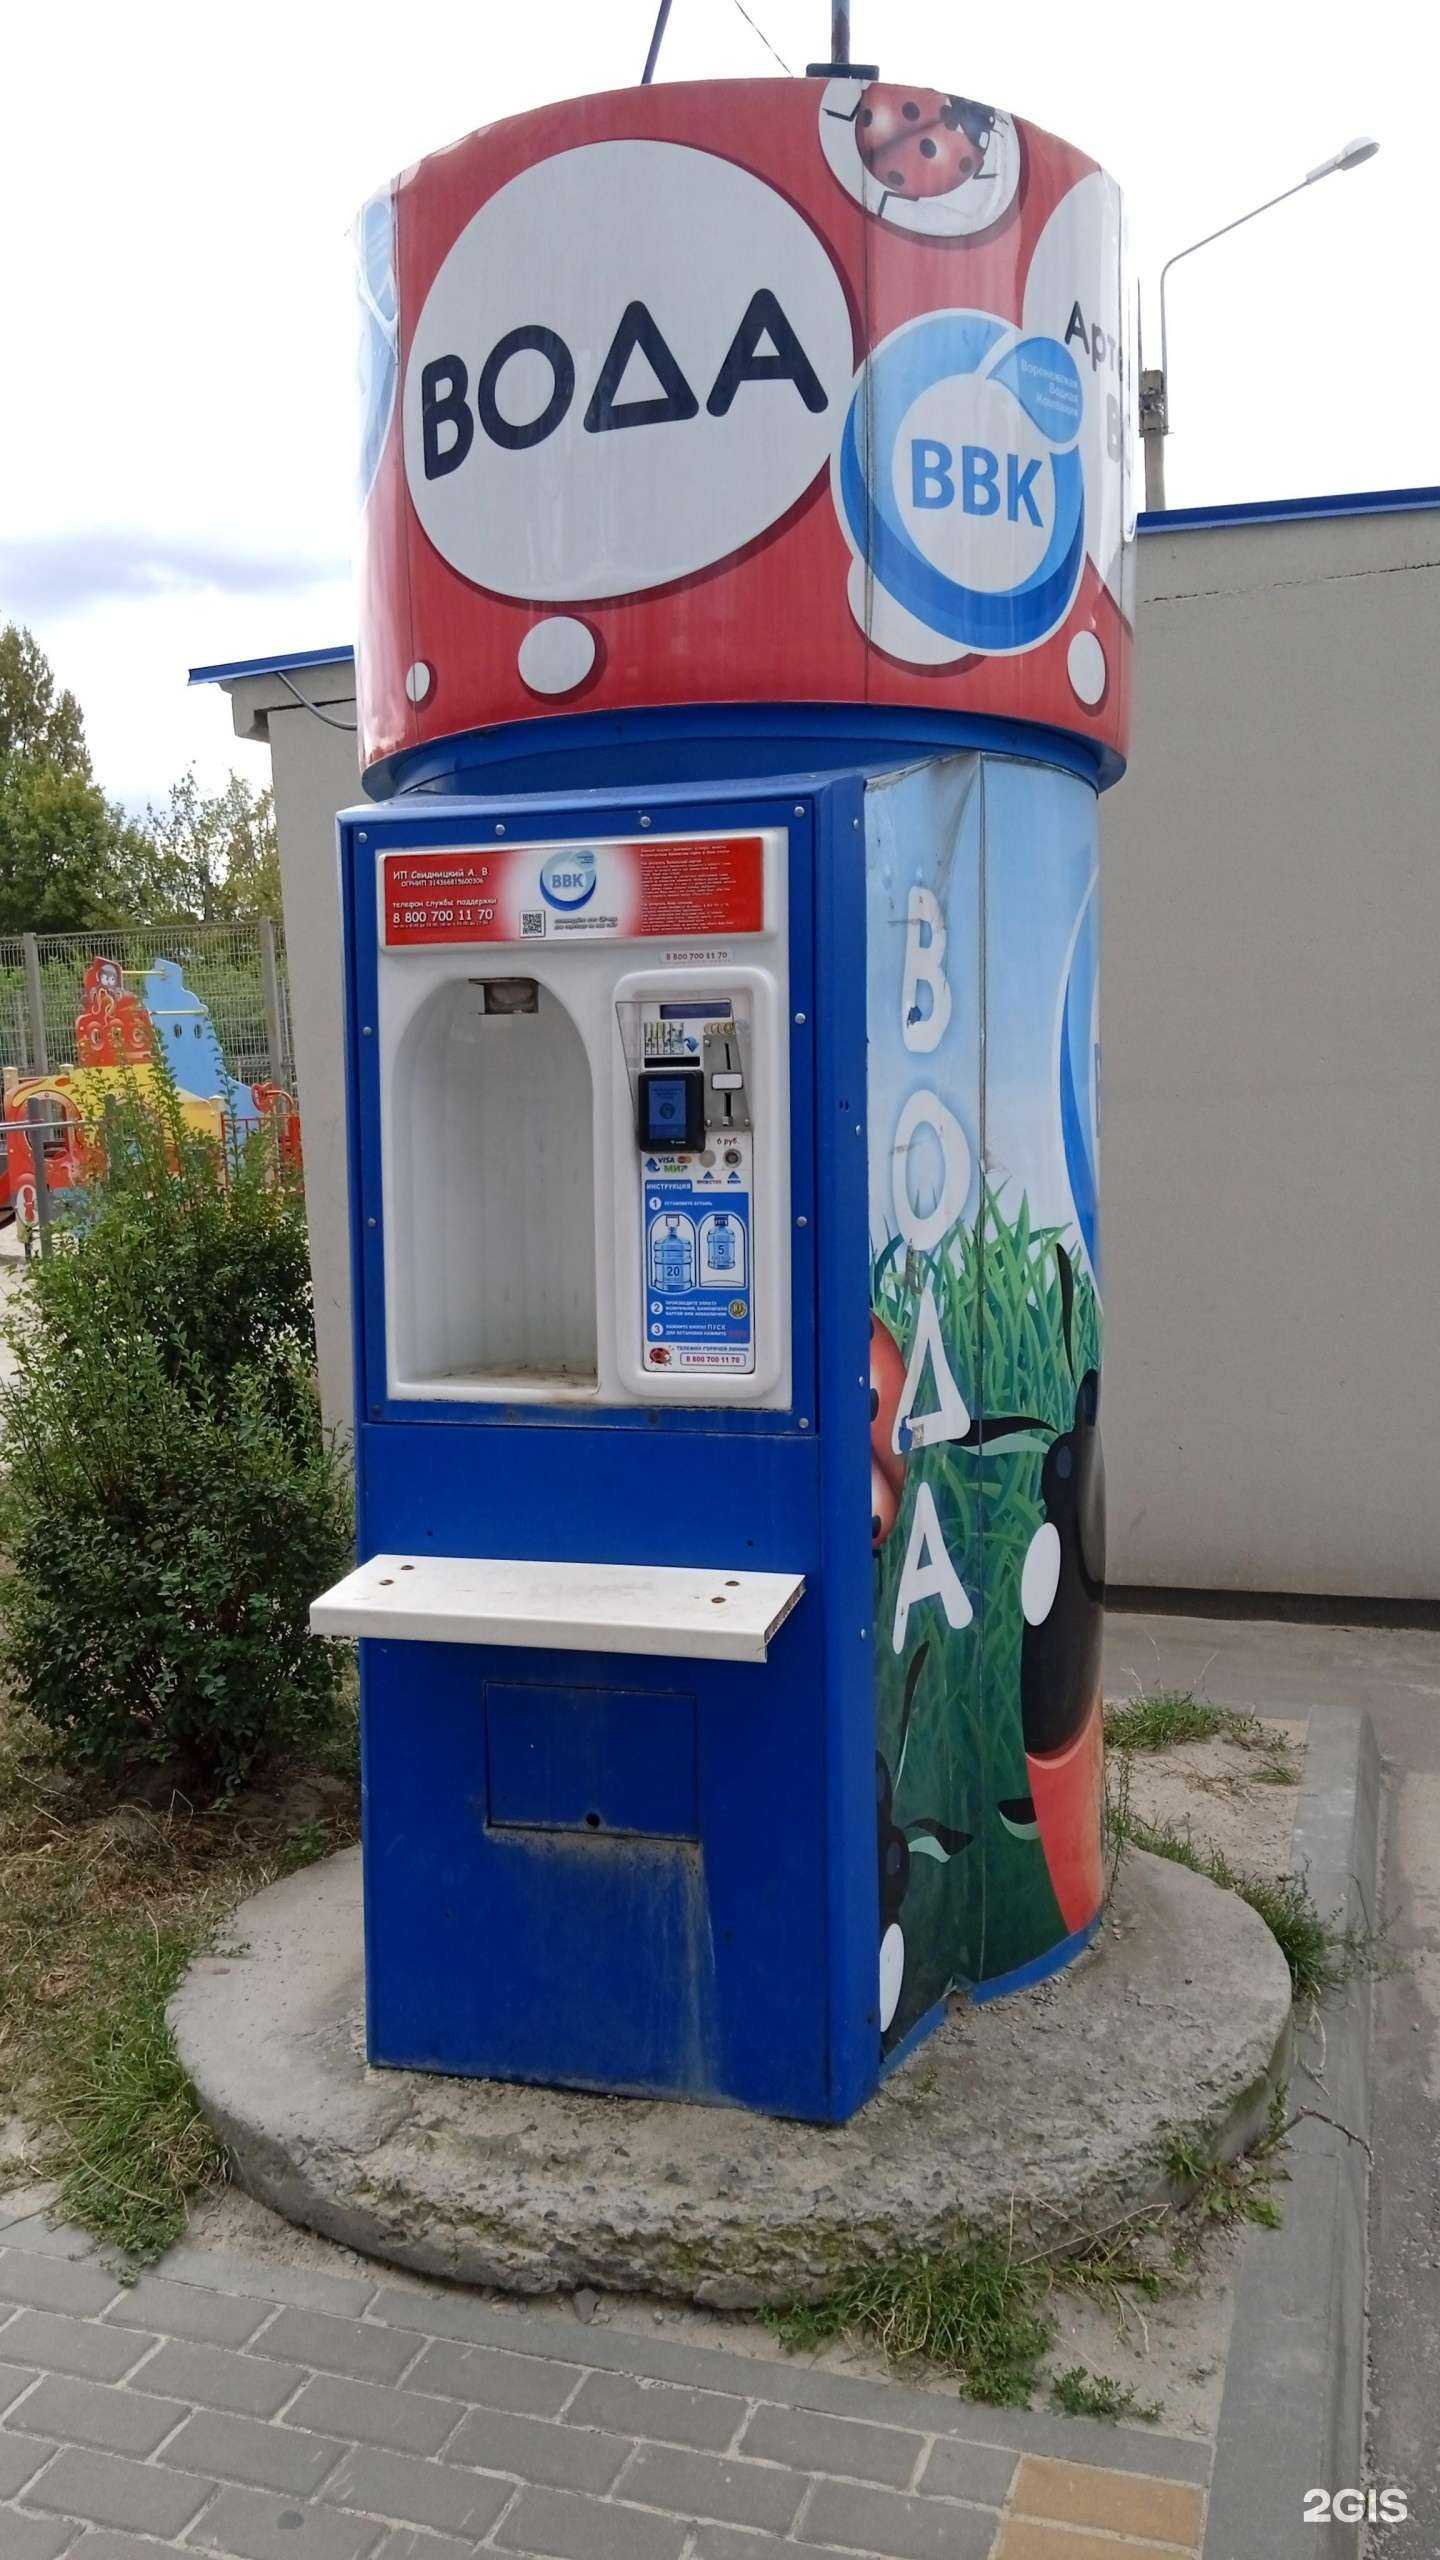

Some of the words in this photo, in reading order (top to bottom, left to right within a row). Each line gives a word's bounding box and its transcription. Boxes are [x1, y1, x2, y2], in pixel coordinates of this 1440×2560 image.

[421, 288, 829, 481] ВОДА
[910, 438, 1044, 529] ВВК
[393, 870, 408, 880] ИП
[411, 868, 464, 879] Свидницкий
[393, 901, 424, 909] телефон
[426, 898, 454, 908] службы
[457, 898, 497, 907] поддержки
[393, 912, 401, 923] 8
[405, 911, 427, 923] 800
[431, 910, 454, 922] 700
[459, 909, 472, 921] 11
[477, 909, 494, 920] 70
[689, 951, 704, 960] 700
[718, 951, 728, 959] 70
[718, 1245, 725, 1255] 5
[667, 1266, 680, 1277] 20
